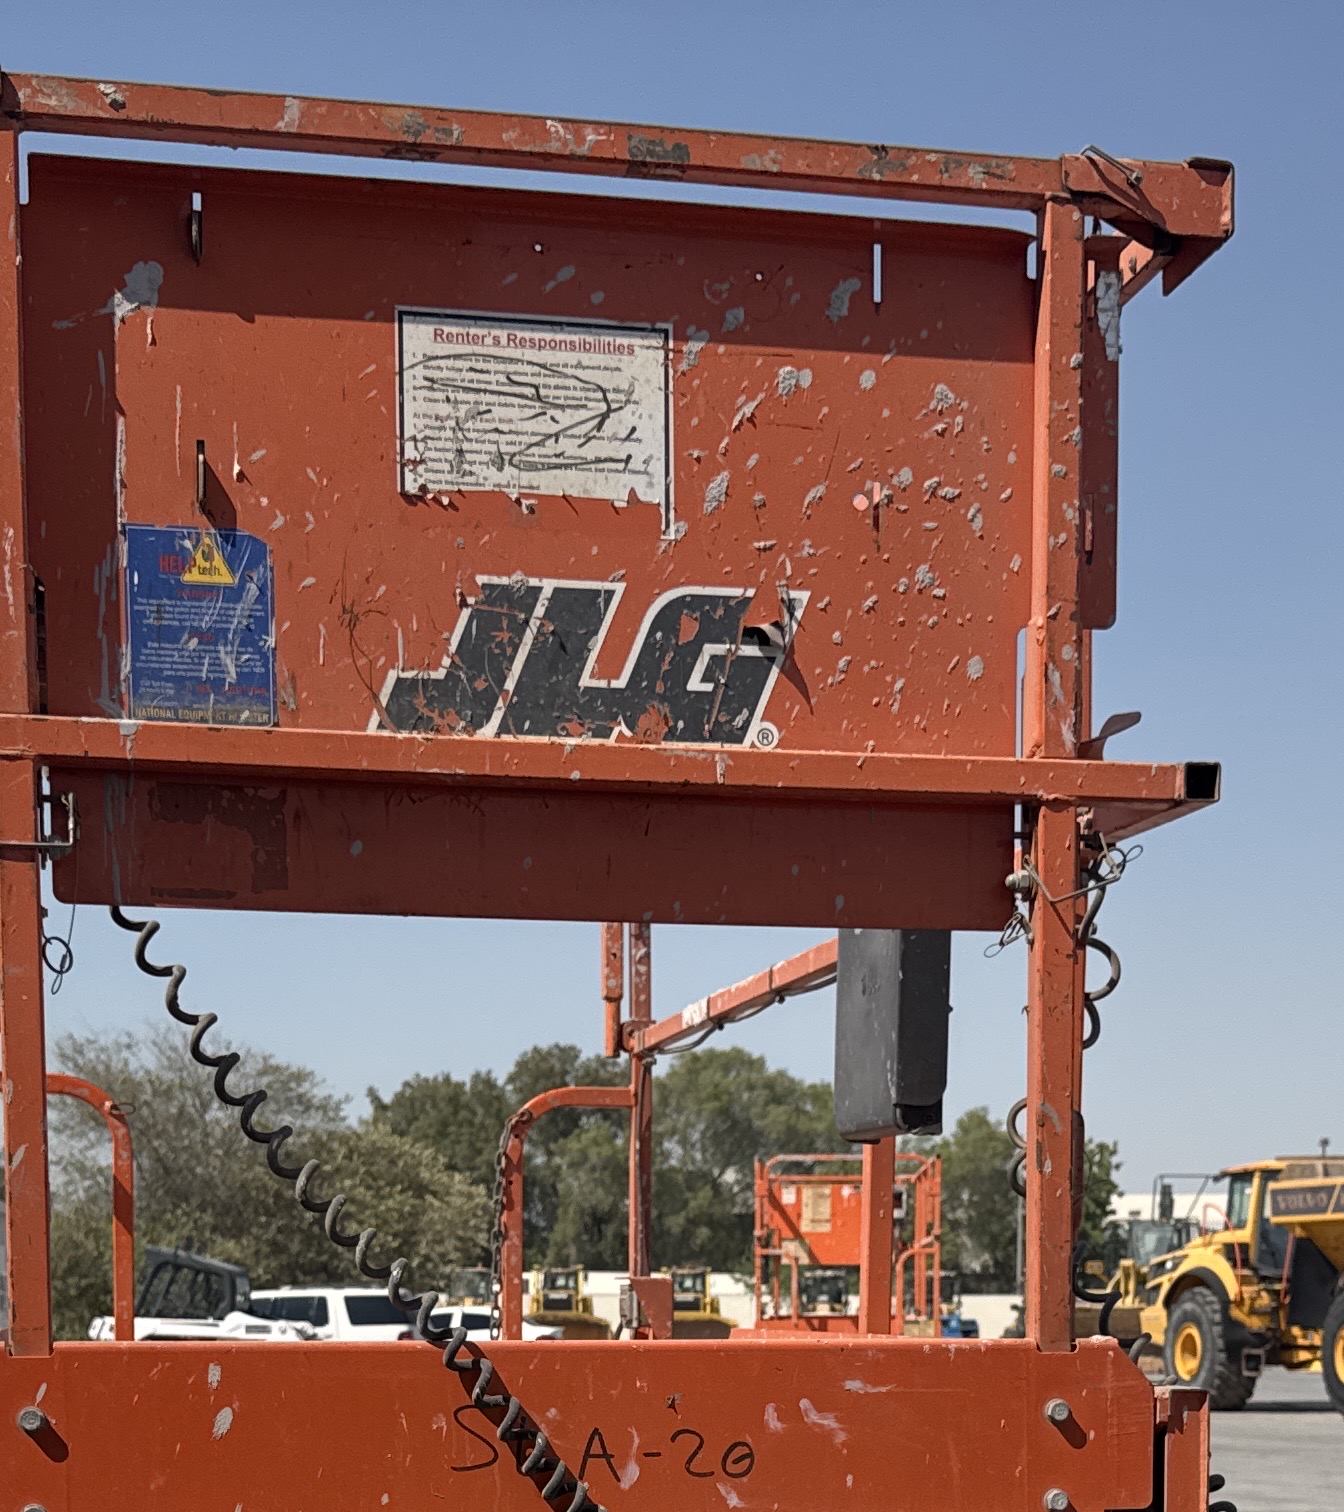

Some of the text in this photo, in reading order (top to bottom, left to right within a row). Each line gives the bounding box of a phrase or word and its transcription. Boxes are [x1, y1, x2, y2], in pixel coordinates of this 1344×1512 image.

[433, 327, 635, 356] Renter's Responsibilities
[367, 574, 812, 748] JLG
[135, 707, 176, 719] NATIONAL
[1276, 1191, 1328, 1211] VOLVO
